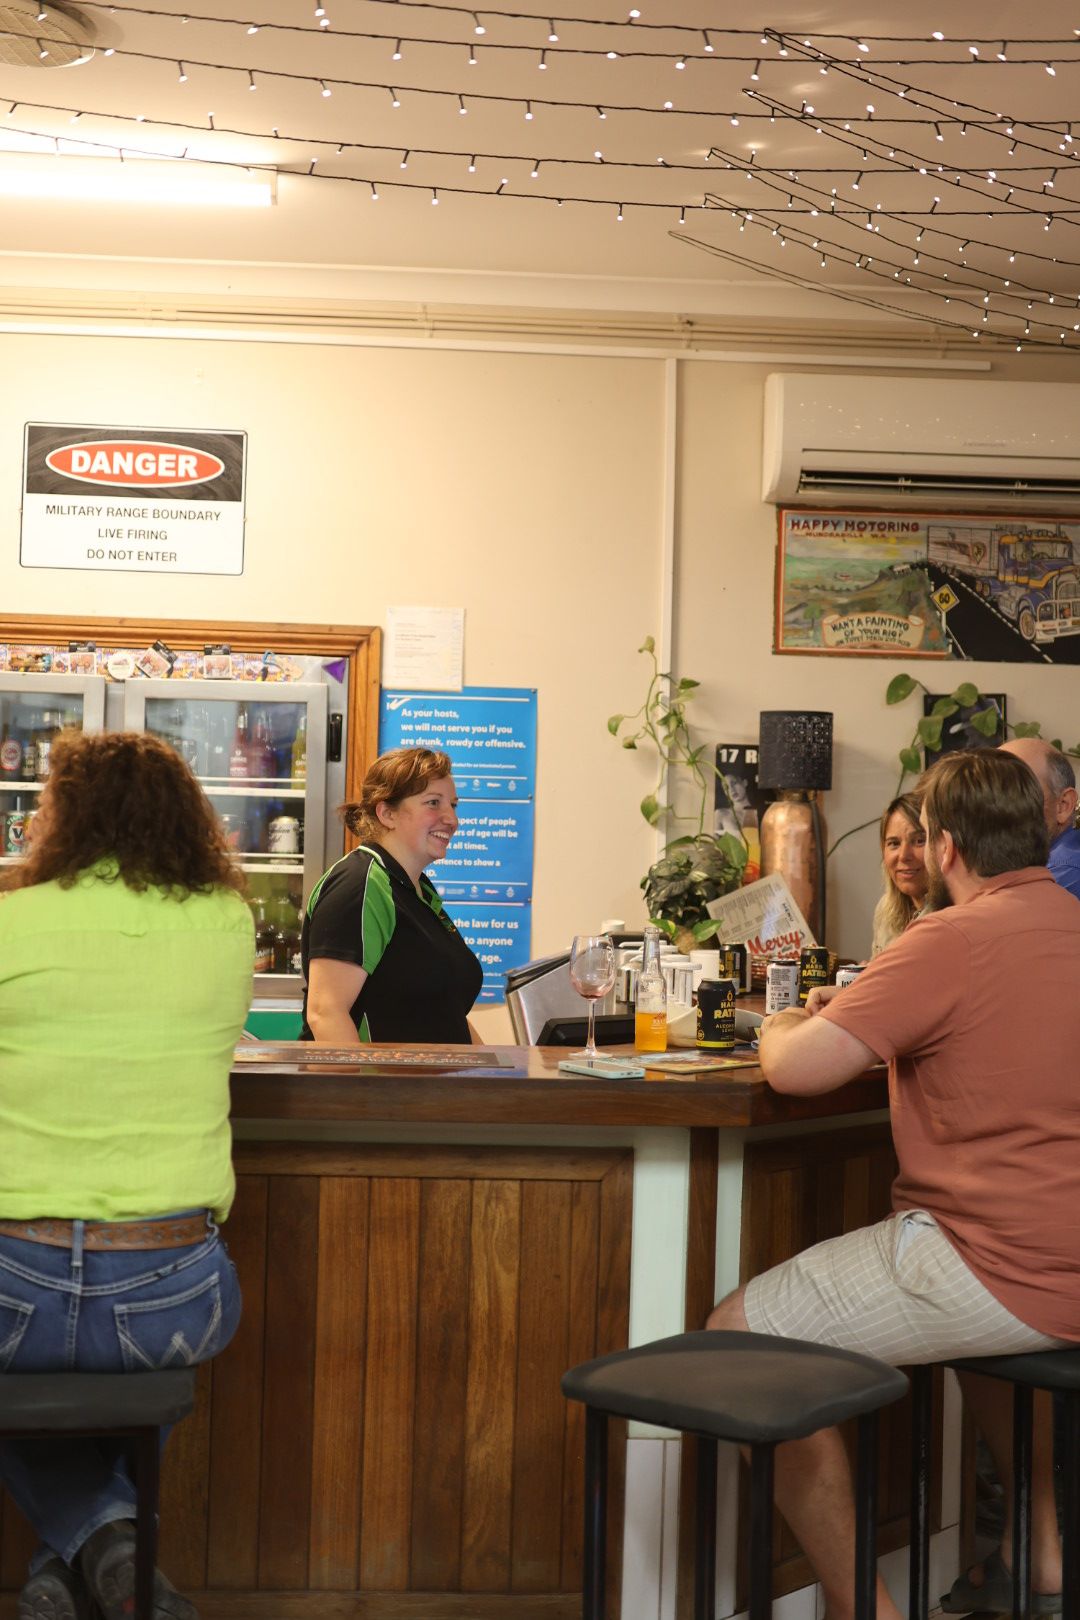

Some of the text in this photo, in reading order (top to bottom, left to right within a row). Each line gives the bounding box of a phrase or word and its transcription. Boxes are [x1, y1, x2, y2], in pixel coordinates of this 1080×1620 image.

[71, 450, 199, 478] DANGER
[46, 505, 221, 521] MILITARY RANGE BOUNDARY
[791, 519, 920, 533] HAPPY MOTORING
[98, 528, 168, 540] LIVE FIRING
[87, 548, 177, 562] DO NOT ENTER
[831, 616, 909, 633] WANT A PAINTING
[859, 628, 881, 637] YOUR
[401, 708, 460, 719] As your hosts,
[415, 722, 430, 731] will
[431, 724, 446, 732] not
[472, 726, 487, 734] you
[489, 724, 496, 733] if
[496, 727, 512, 735] you
[415, 736, 444, 746] drunk,
[446, 738, 473, 749] rowdy
[485, 739, 526, 749] offensive.
[719, 748, 739, 763] 17
[479, 816, 488, 825] of
[488, 817, 517, 827] people
[466, 828, 476, 836] of
[476, 830, 491, 839] age
[492, 828, 507, 838] will
[507, 829, 518, 838] be
[464, 842, 489, 850] times.
[464, 857, 472, 866] to
[473, 858, 494, 867] show
[454, 918, 519, 929] the law for us
[464, 936, 513, 947] to anyone
[747, 930, 801, 955] Merry
[481, 955, 503, 964] age.
[802, 970, 826, 978] RATED
